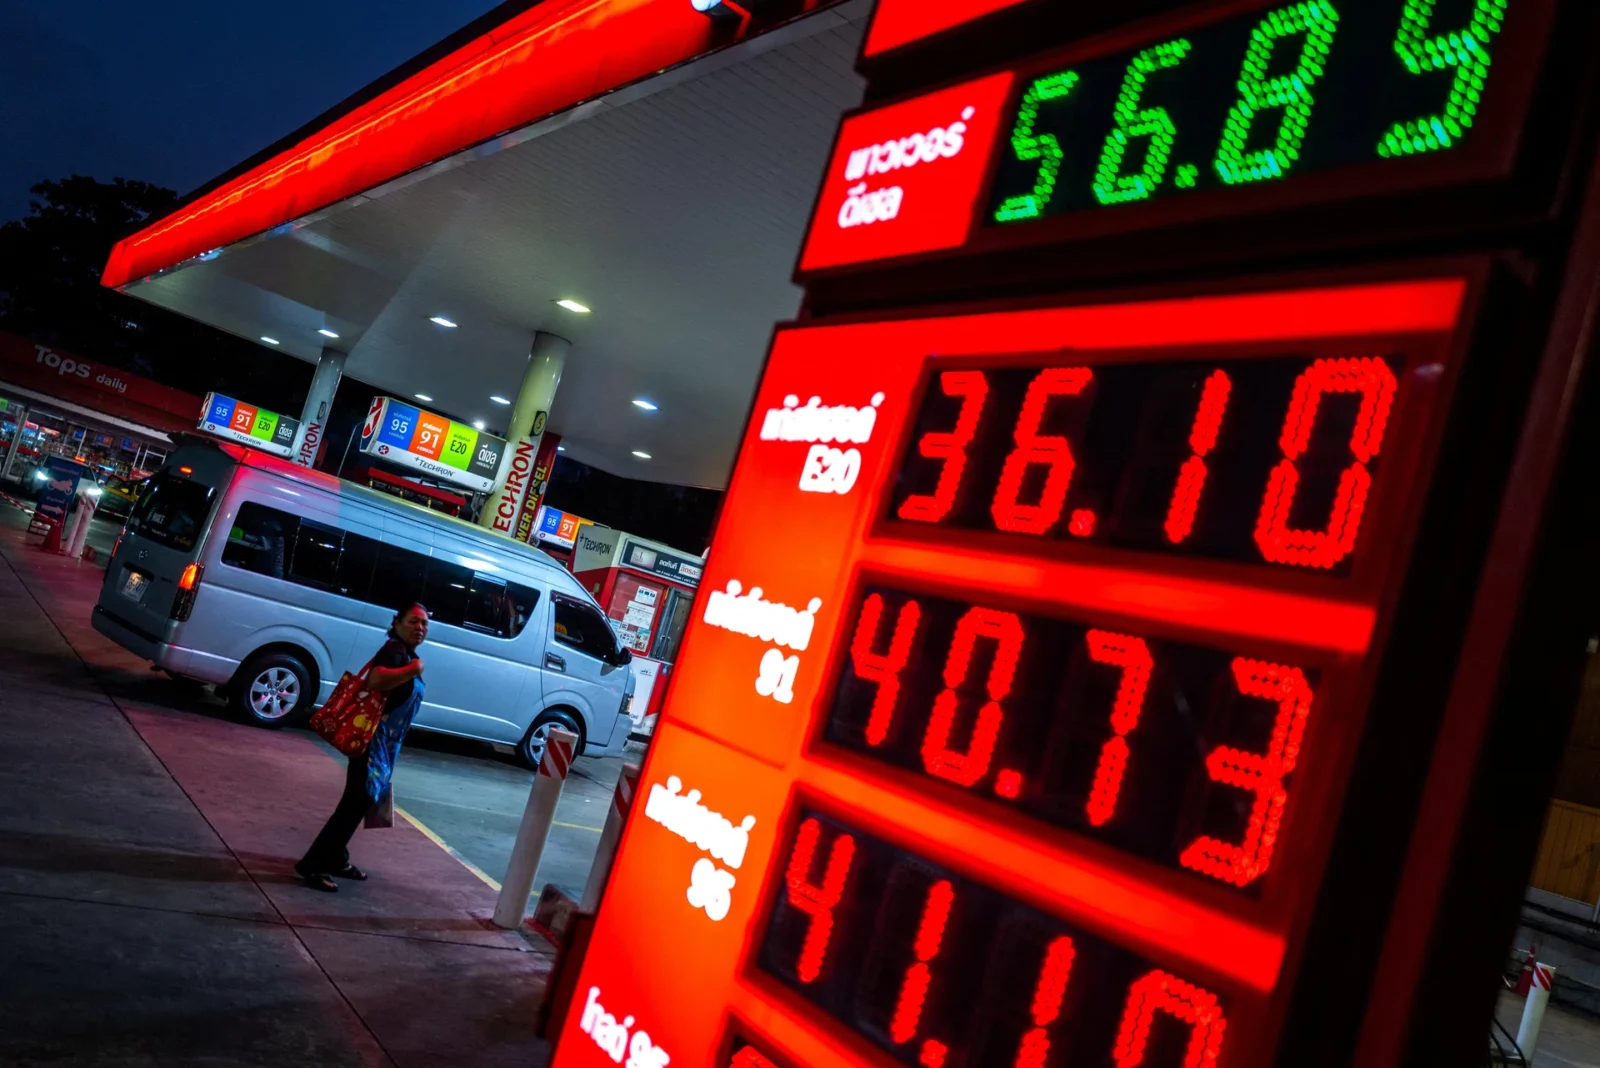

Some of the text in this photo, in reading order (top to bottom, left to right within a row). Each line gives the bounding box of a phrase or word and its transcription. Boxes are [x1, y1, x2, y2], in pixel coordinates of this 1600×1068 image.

[995, 0, 1507, 221] 56.89
[34, 344, 127, 393] Tops daily
[215, 406, 229, 417] 95
[237, 414, 251, 427] 91
[258, 421, 271, 432] E20
[391, 419, 409, 434] 95
[419, 430, 440, 448] 91
[298, 422, 321, 466] HRON
[450, 440, 467, 455] E20
[478, 444, 497, 464] ดีเซล
[799, 444, 861, 494] E20
[898, 357, 1397, 569] 36.10
[492, 440, 535, 532] ECHRON
[516, 512, 533, 541] WER
[547, 518, 557, 527] 95
[562, 523, 573, 534] 91
[754, 648, 799, 704] 91
[850, 593, 1312, 887] 40.73
[687, 858, 736, 921] 95
